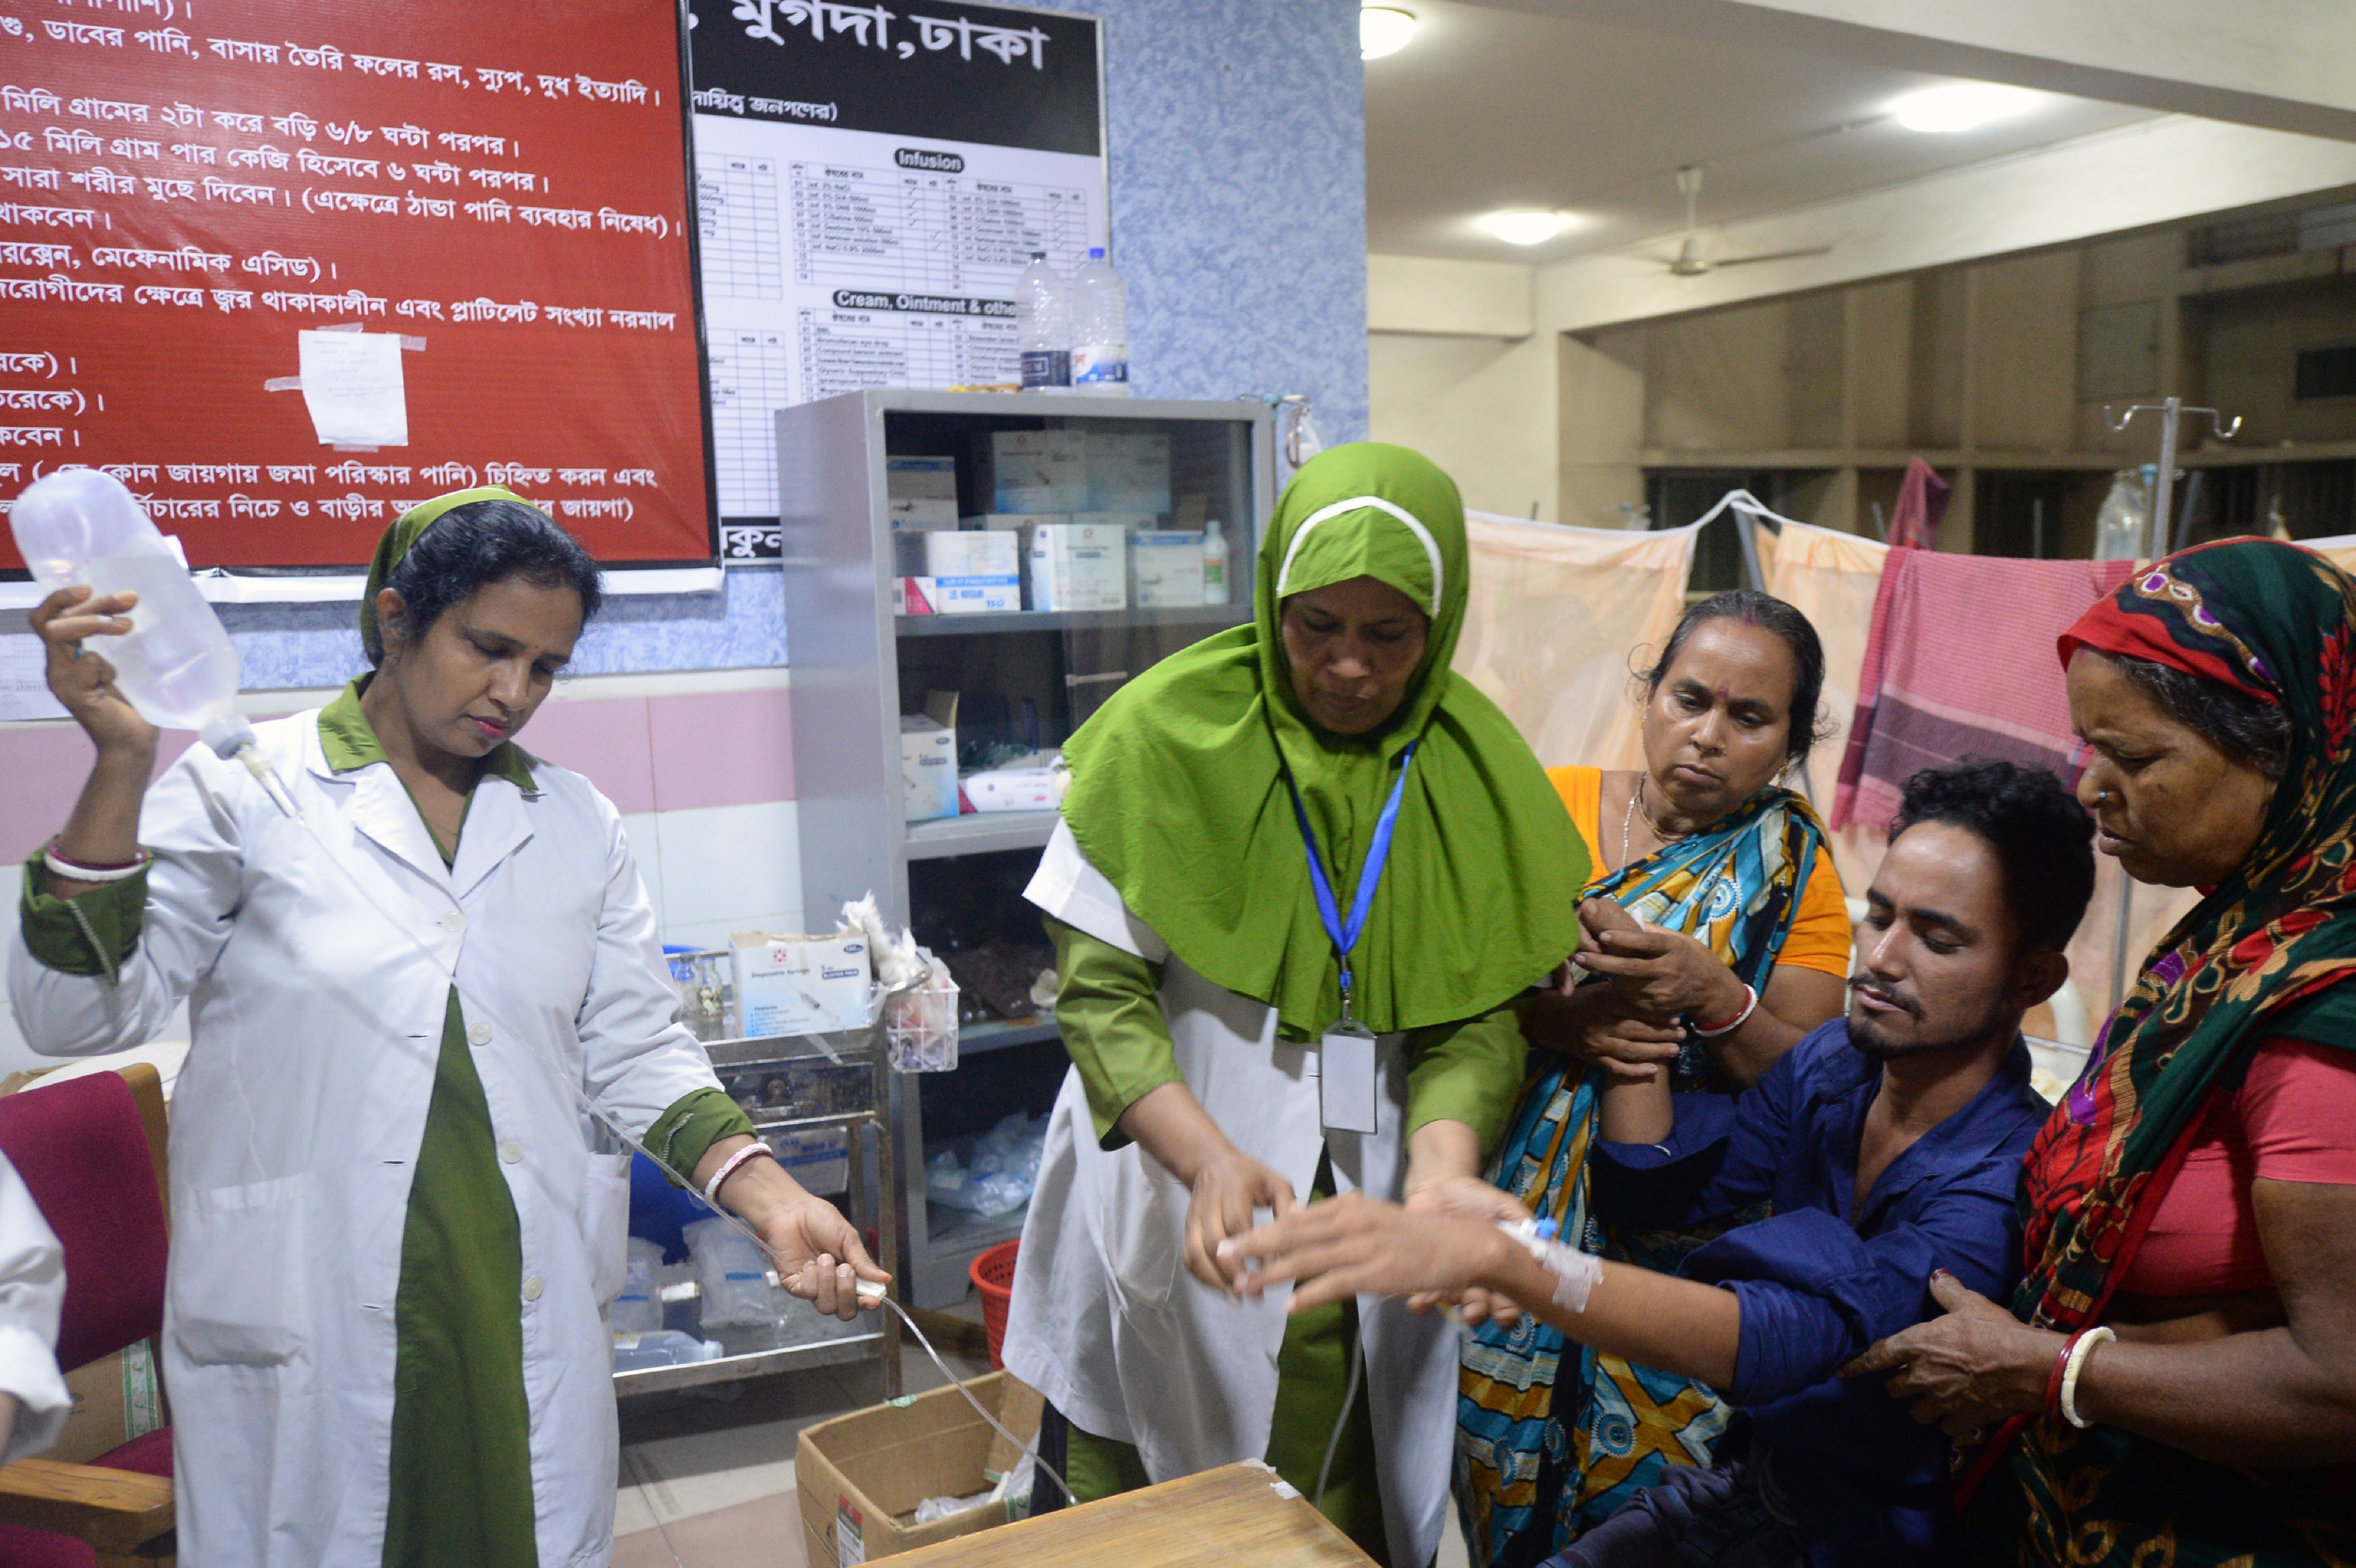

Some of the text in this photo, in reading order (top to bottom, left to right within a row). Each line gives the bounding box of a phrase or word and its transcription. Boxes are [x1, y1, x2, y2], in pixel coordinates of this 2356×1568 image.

[42, 21, 125, 47] ডাবের
[134, 27, 199, 59] পানি,
[207, 39, 280, 64] বাসায়
[284, 41, 345, 71] তৈরি
[350, 54, 420, 79] ফলের
[425, 62, 469, 88] রস,
[476, 68, 531, 95] স্যুপ,
[536, 75, 571, 99] দুধ
[575, 73, 648, 105] ইত্যাদি
[1, 85, 62, 115] মিলি
[69, 97, 150, 122] গ্রামের
[161, 101, 204, 128] ২টা
[211, 111, 264, 132] করে
[270, 112, 318, 141] বড়ি
[325, 120, 373, 145] ৬/৮
[380, 122, 430, 149] ঘন্টা
[437, 131, 506, 155] পরপর
[43, 127, 103, 155] মিলি
[110, 138, 160, 160] গ্রাম
[171, 144, 216, 164] পার
[228, 145, 290, 171] কেজি
[296, 148, 380, 178] হিসেবে
[387, 162, 406, 180] ৬
[412, 160, 461, 186] ঘন্টা
[469, 168, 535, 191] পরপর
[899, 150, 962, 171] Infusion
[0, 167, 60, 190] সারা
[67, 166, 137, 194] শরীর
[142, 178, 196, 203] মুছে
[202, 176, 275, 206] দিবেন
[302, 187, 400, 215] (এক্ষেত্রে
[404, 190, 457, 219] ঠান্ডা
[464, 198, 513, 223] পানি
[517, 206, 593, 230] ব্যবহার
[597, 207, 668, 239] নিষেধ)
[0, 242, 81, 269] রক্সেন,
[92, 246, 232, 272] মেফেনামিক
[242, 250, 320, 283] এসিড)
[134, 286, 204, 308] ক্ষেত্রে
[210, 289, 253, 314] জ্বর
[262, 289, 388, 316] থাকাকালীন
[396, 299, 445, 321] এবং
[450, 297, 539, 323] প্লাটিলেট
[544, 306, 604, 327] সংখ্যা
[608, 310, 676, 331] নরমাল
[838, 291, 1017, 316] Cream, Ointment & othe
[164, 463, 261, 484] জায়গায়
[266, 464, 317, 485] জমা
[325, 460, 412, 485] পরিস্কার
[420, 461, 477, 489] পানি)
[484, 462, 551, 488] চিহ্নিত
[613, 469, 658, 488] এবং
[227, 493, 282, 518] নিচে
[290, 501, 309, 516] ও
[316, 493, 385, 522] বাড়ীর
[560, 498, 633, 522] জায়গা)
